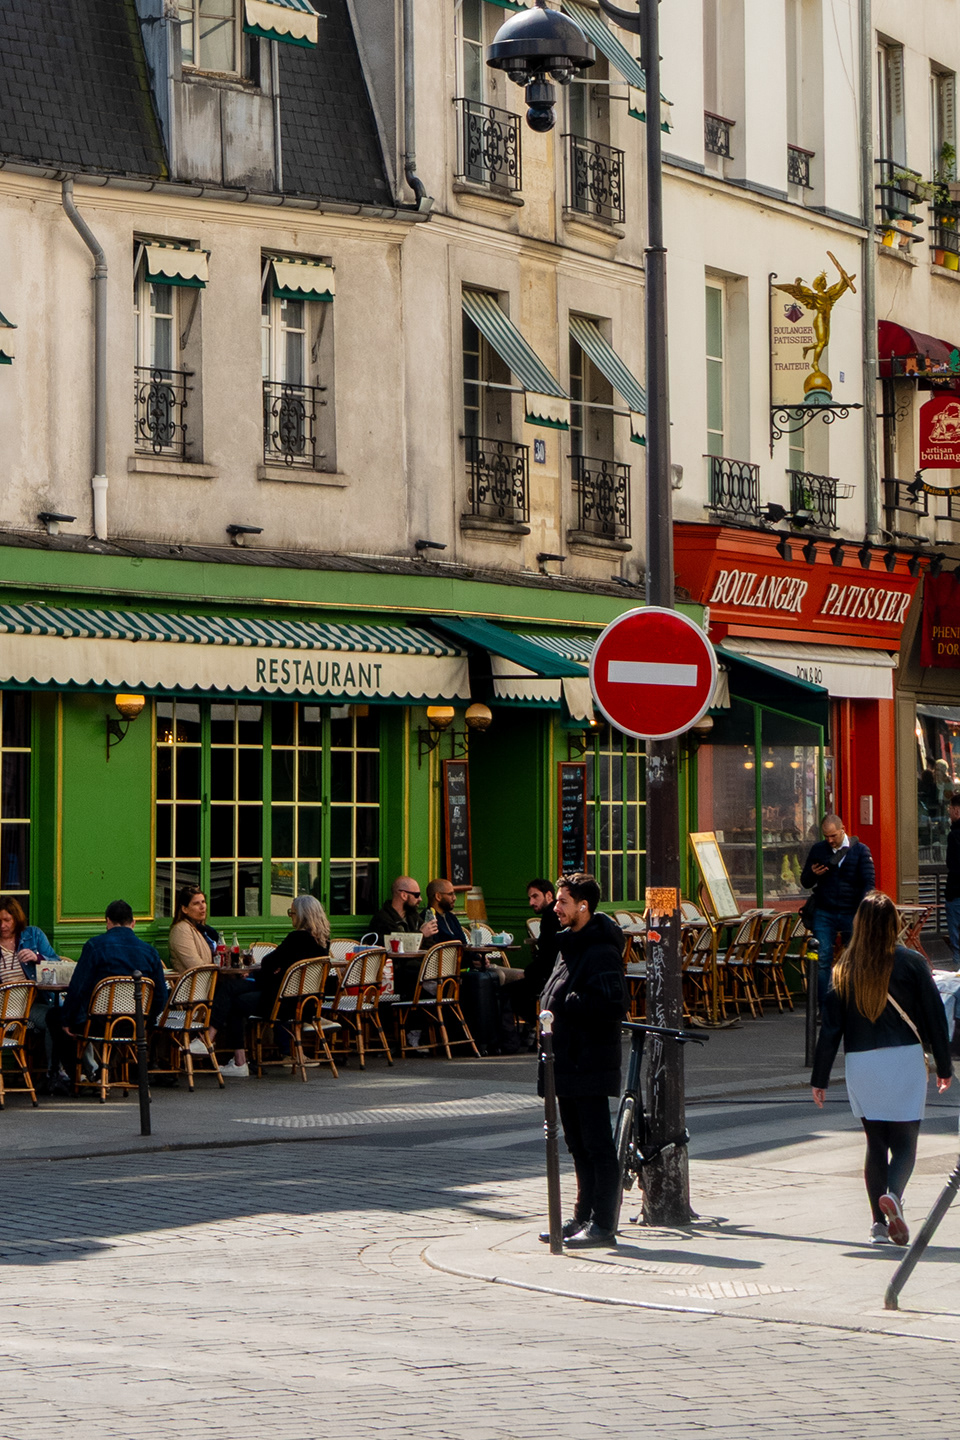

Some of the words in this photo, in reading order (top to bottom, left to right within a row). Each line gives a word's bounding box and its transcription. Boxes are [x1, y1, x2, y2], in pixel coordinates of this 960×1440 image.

[773, 327, 813, 335] BOULANGER
[773, 336, 813, 344] PATISSIER
[774, 362, 810, 371] TRAITEUR
[535, 442, 544, 461] 30
[925, 446, 953, 454] artisan
[709, 569, 809, 614] BOULANGER
[820, 583, 912, 624] PATISSIER
[256, 658, 382, 689] RESTAURANT
